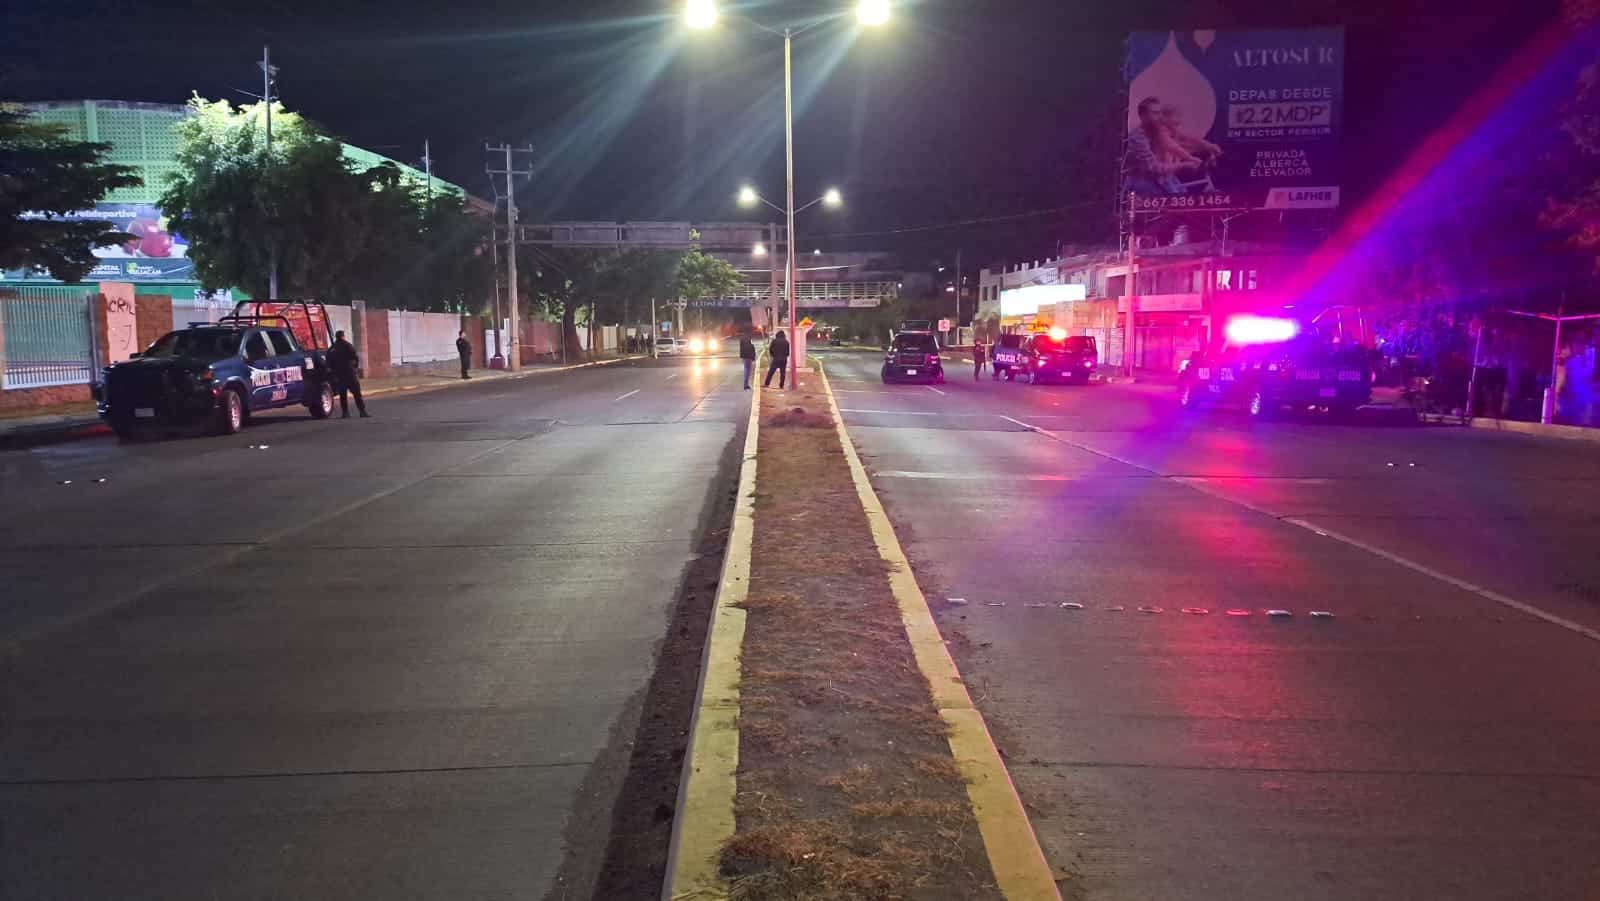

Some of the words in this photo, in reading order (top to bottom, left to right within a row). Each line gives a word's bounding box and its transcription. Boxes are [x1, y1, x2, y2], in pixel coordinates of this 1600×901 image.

[1230, 47, 1334, 66] ALTOSUR
[1229, 89, 1277, 101] DEPAS
[1281, 87, 1332, 99] DESDE
[1256, 150, 1306, 159] PRIVADA
[1255, 159, 1309, 168] ALBERCA
[1250, 167, 1312, 177] ELEVADOR
[1143, 197, 1168, 208] 667
[1170, 196, 1195, 207] 336
